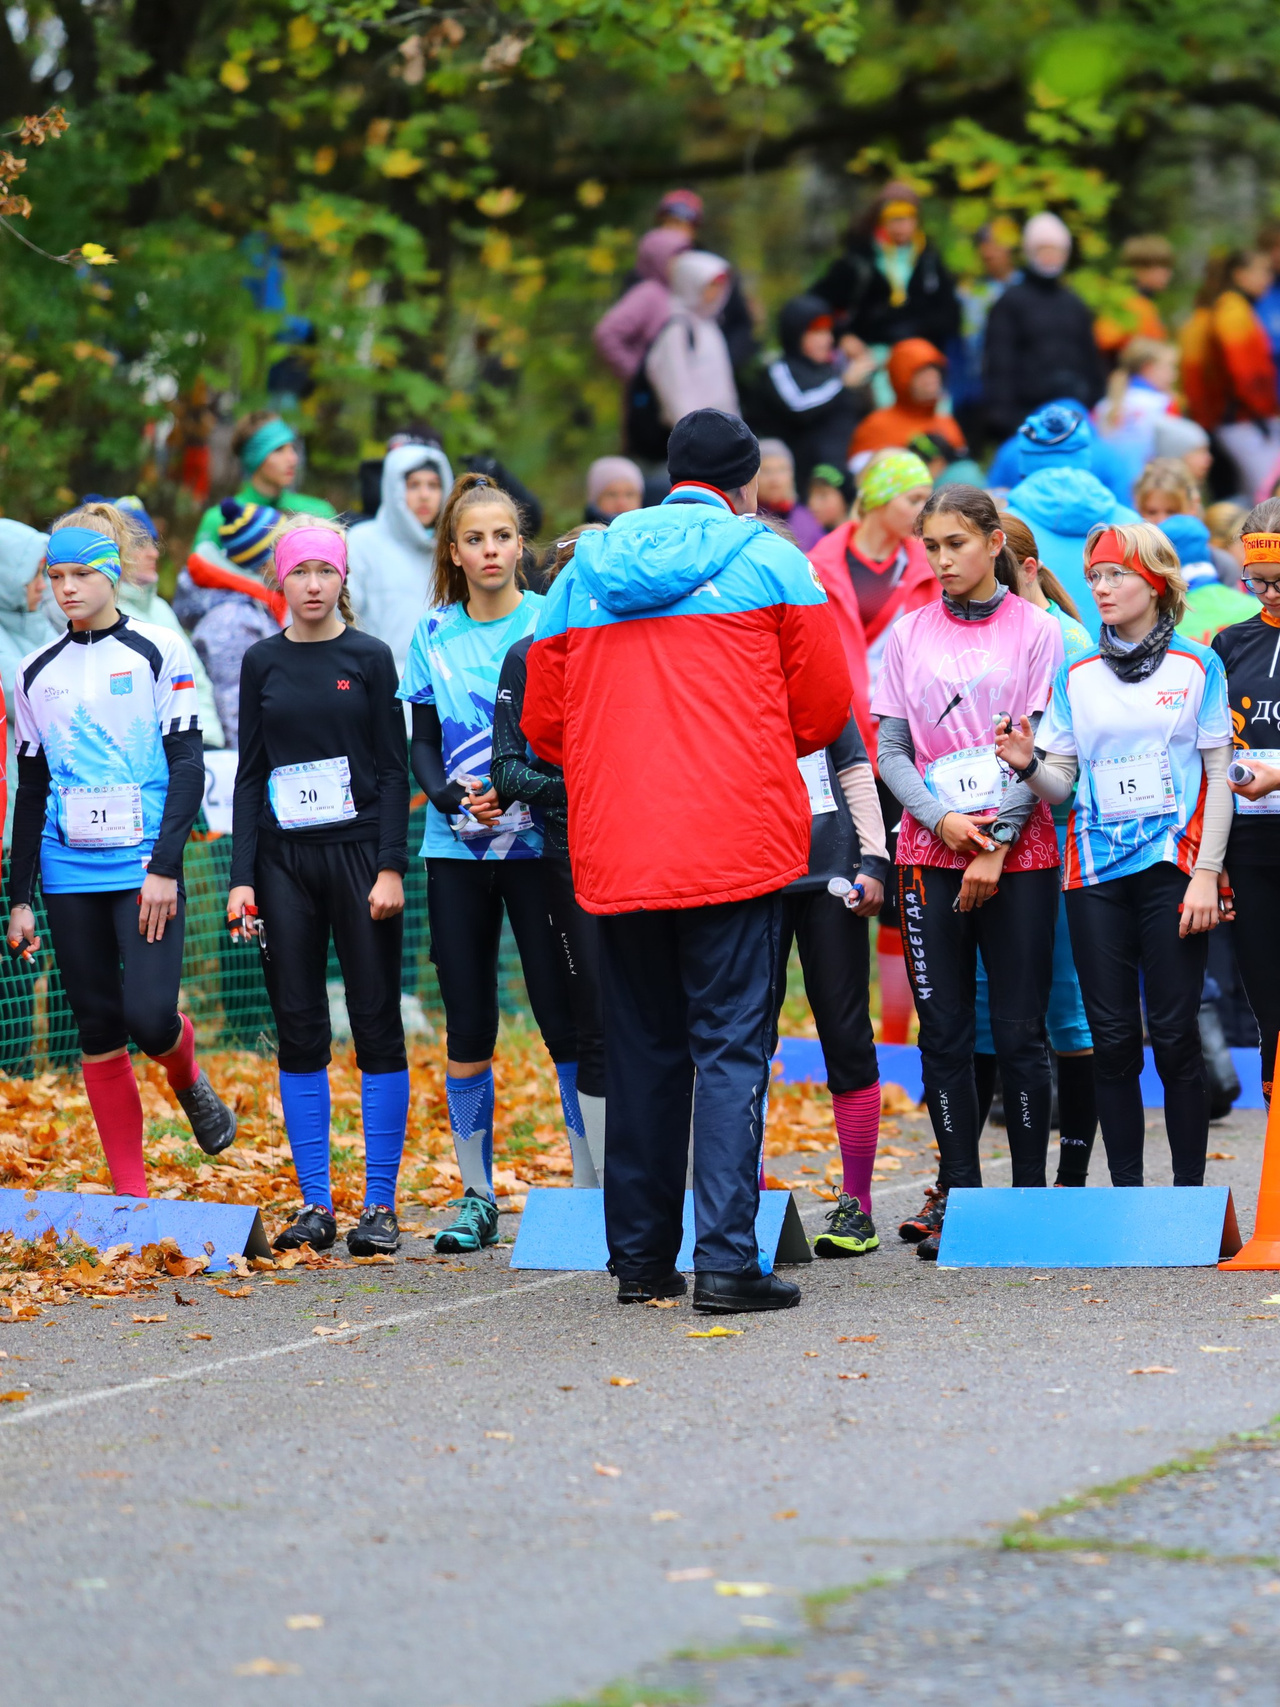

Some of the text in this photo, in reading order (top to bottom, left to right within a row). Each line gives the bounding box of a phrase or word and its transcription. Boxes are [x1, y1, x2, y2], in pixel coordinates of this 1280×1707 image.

[959, 775, 977, 792] 16
[1119, 779, 1137, 795] 15
[299, 789, 318, 804] 20
[90, 809, 107, 824] 21
[905, 892, 933, 1000] НАВСЕГДА
